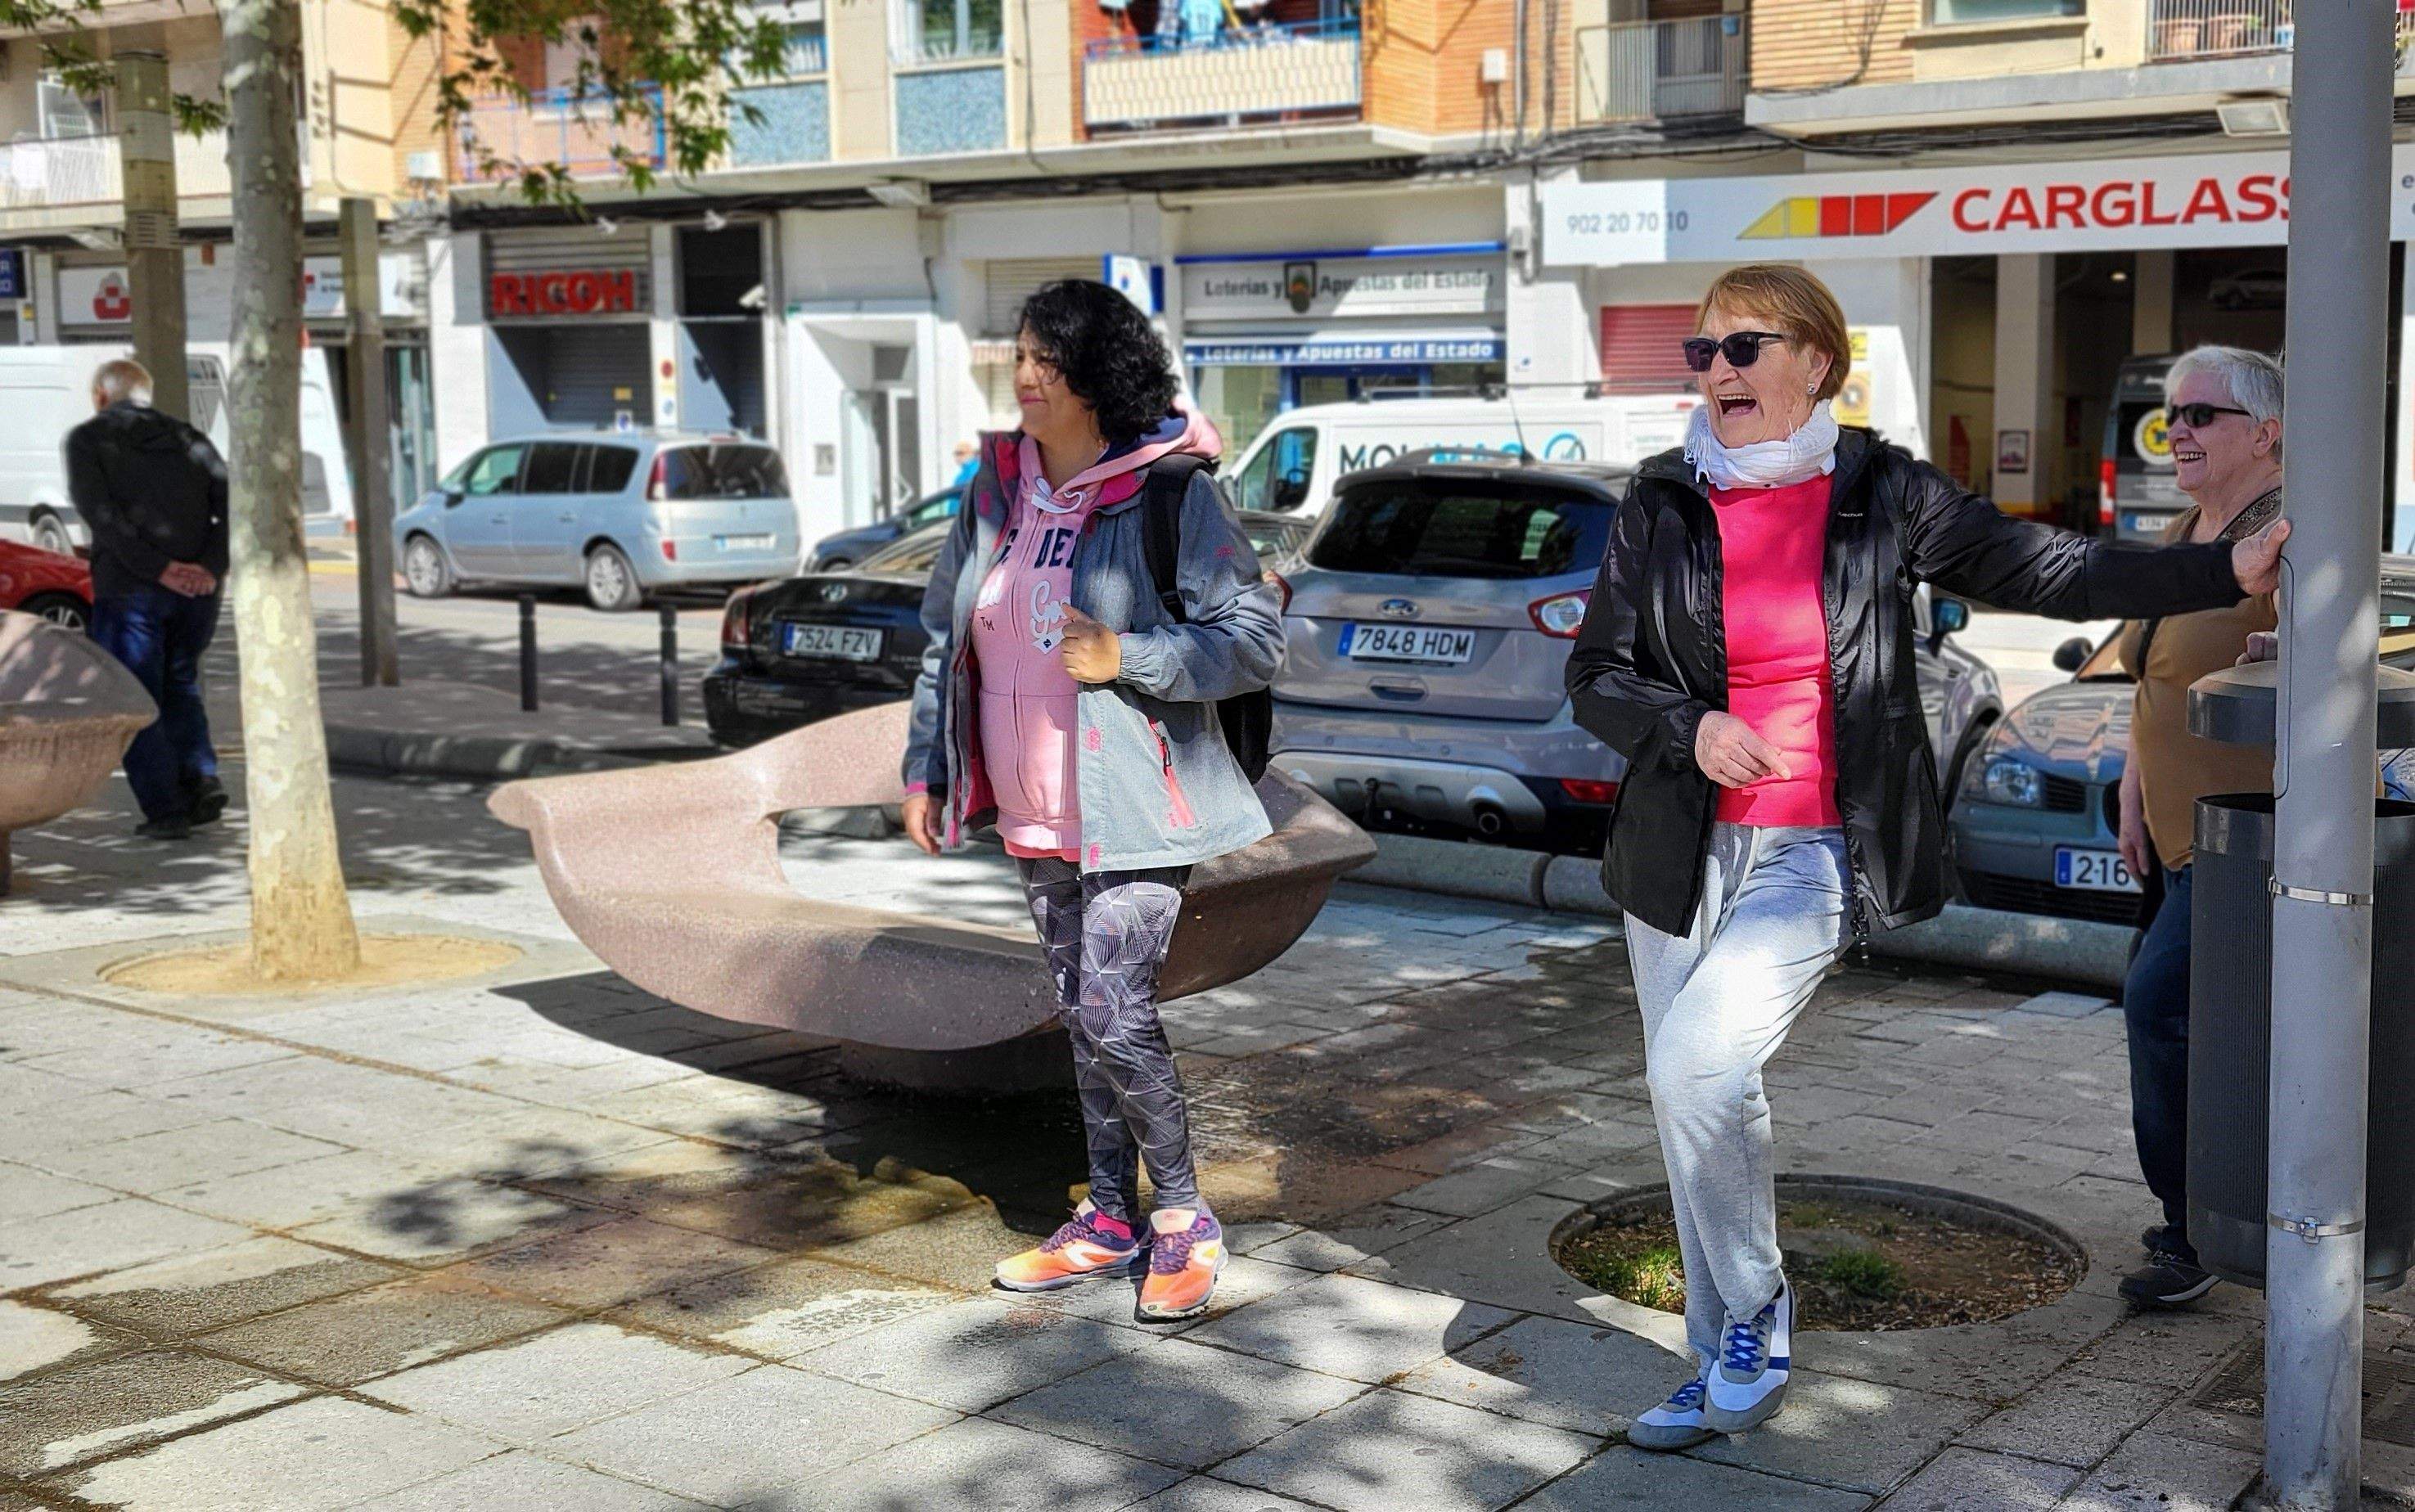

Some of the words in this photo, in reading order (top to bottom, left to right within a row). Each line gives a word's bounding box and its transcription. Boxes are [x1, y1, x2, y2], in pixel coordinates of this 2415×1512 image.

[1953, 175, 2289, 233] CARGLAS
[1567, 214, 1602, 234] 902
[1607, 212, 1630, 233] 20
[1637, 211, 1659, 232] 70
[1667, 209, 1688, 232] 10
[493, 268, 634, 315] RICOH
[1274, 282, 1283, 299] y
[1320, 275, 1395, 296] Apuestas
[1402, 271, 1428, 290] del
[1434, 268, 1493, 289] Estado
[1282, 347, 1293, 363] y
[1297, 345, 1383, 362] Apuestas
[1390, 344, 1419, 358] del
[1426, 343, 1493, 358] Estado
[980, 616, 995, 632] TM
[795, 627, 834, 650] 7524
[1358, 628, 1416, 654] 7848
[1422, 632, 1471, 658] HDM
